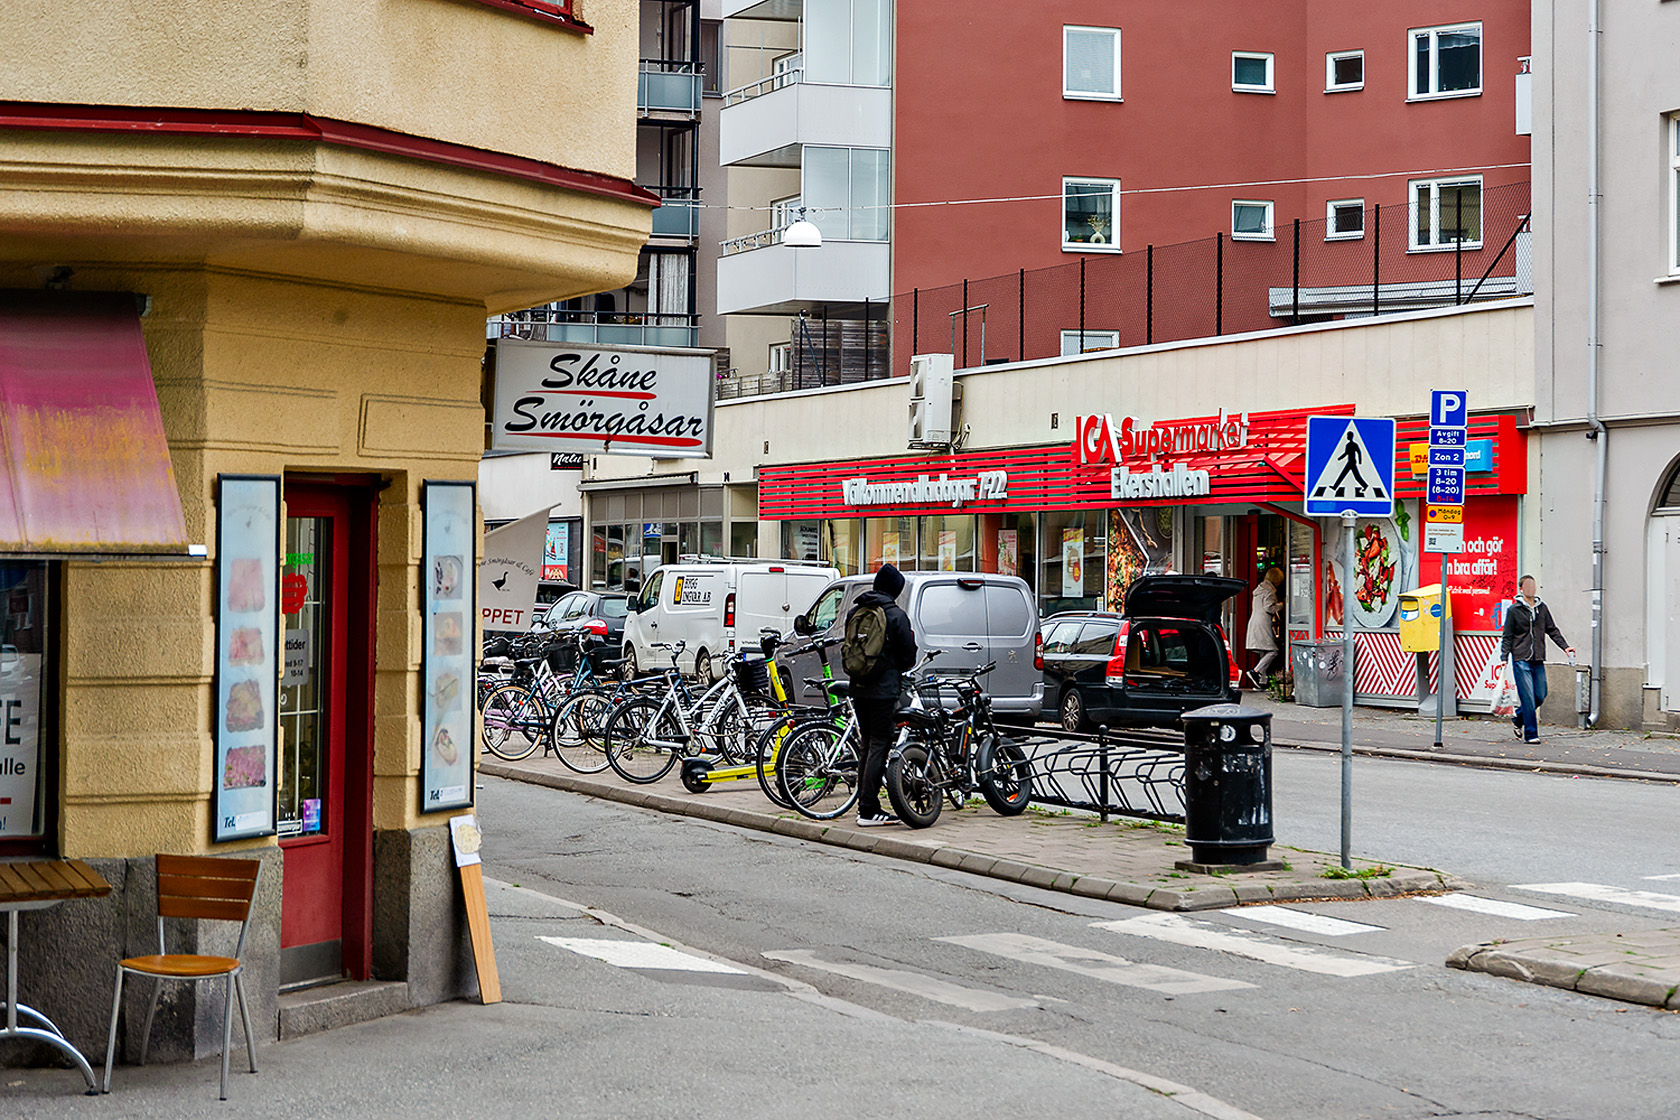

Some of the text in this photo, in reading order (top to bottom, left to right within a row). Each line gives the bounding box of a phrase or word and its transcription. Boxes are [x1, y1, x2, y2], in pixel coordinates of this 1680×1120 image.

[541, 353, 657, 390] Skåne
[1439, 393, 1461, 423] P
[504, 396, 704, 445] Smörgåsar
[1076, 408, 1250, 464] ICA Supermarket
[1436, 430, 1460, 438] Avgift
[1438, 437, 1457, 445] 8-20
[1434, 452, 1459, 461] Zon 2
[1111, 462, 1210, 499] Ekershallen
[1435, 468, 1457, 476] 3 tim
[1435, 477, 1457, 485] 8-20
[842, 477, 913, 506] Välkommen
[911, 475, 936, 502] alla
[1432, 485, 1460, 494] (8-20)
[1467, 537, 1485, 553] och
[1486, 536, 1504, 556] gör
[1453, 559, 1470, 575] bra
[1471, 559, 1498, 576] affär!
